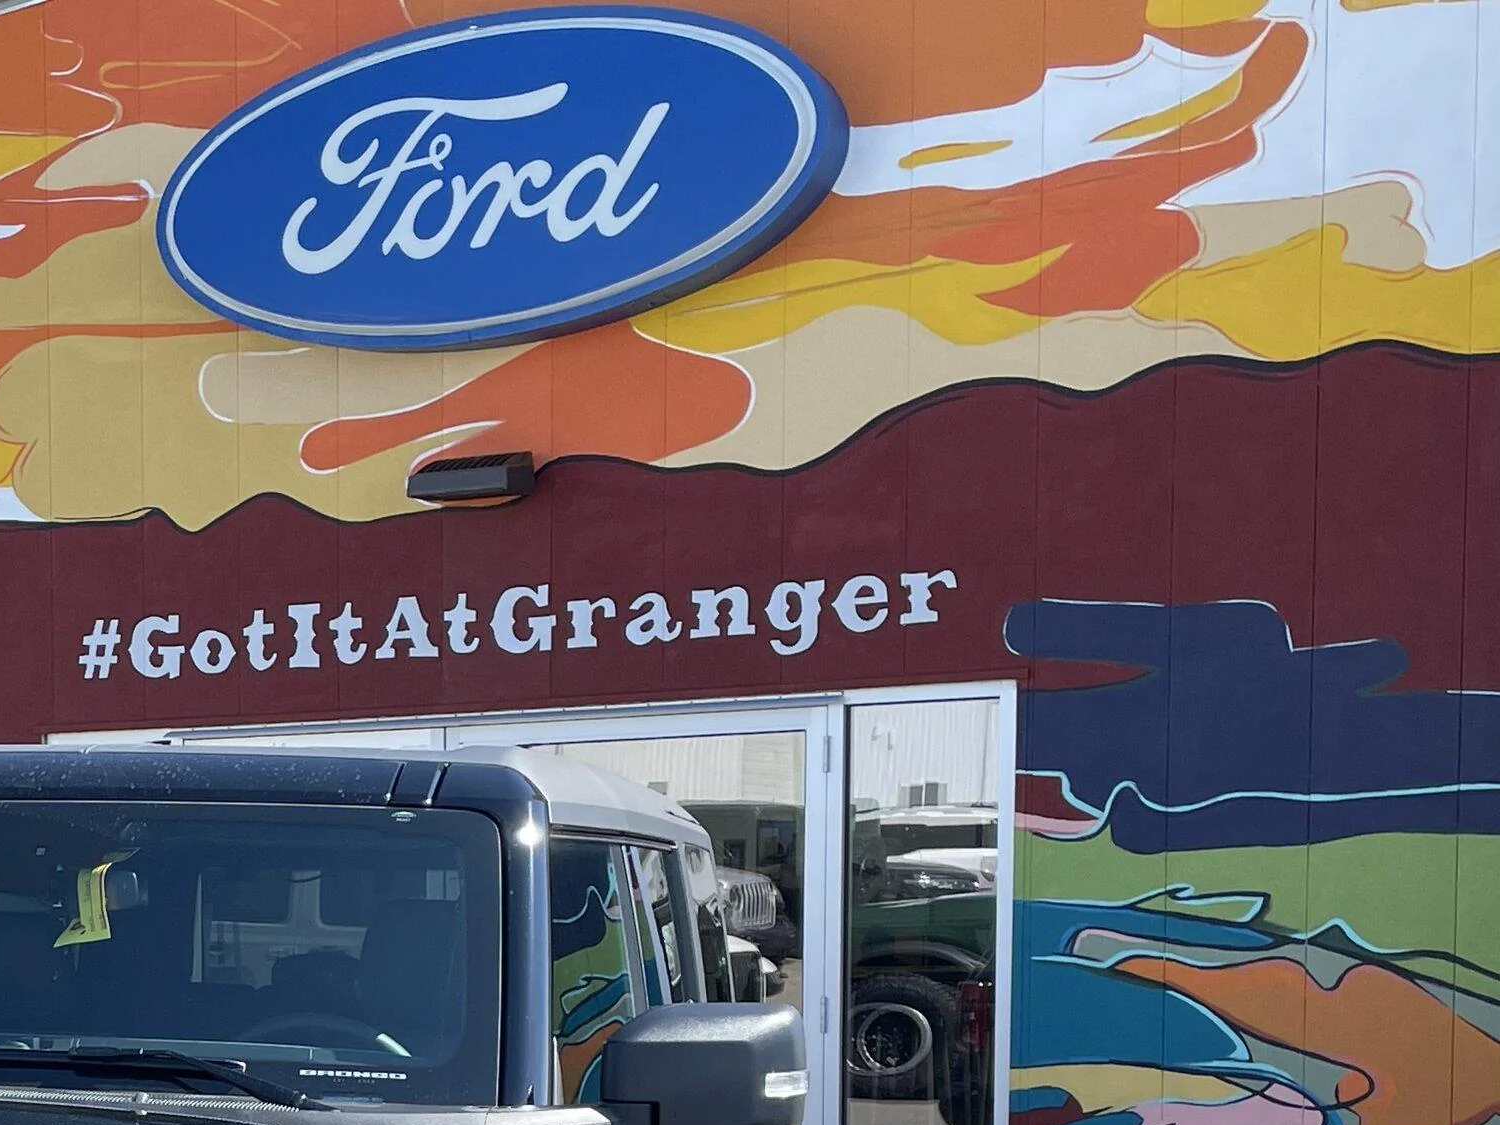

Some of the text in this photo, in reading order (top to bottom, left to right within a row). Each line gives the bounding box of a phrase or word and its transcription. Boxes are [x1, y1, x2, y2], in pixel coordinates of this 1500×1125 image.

[281, 82, 670, 275] Ford
[78, 567, 958, 680] #GotItAtGranger
[299, 1069, 407, 1079] BRONCO
